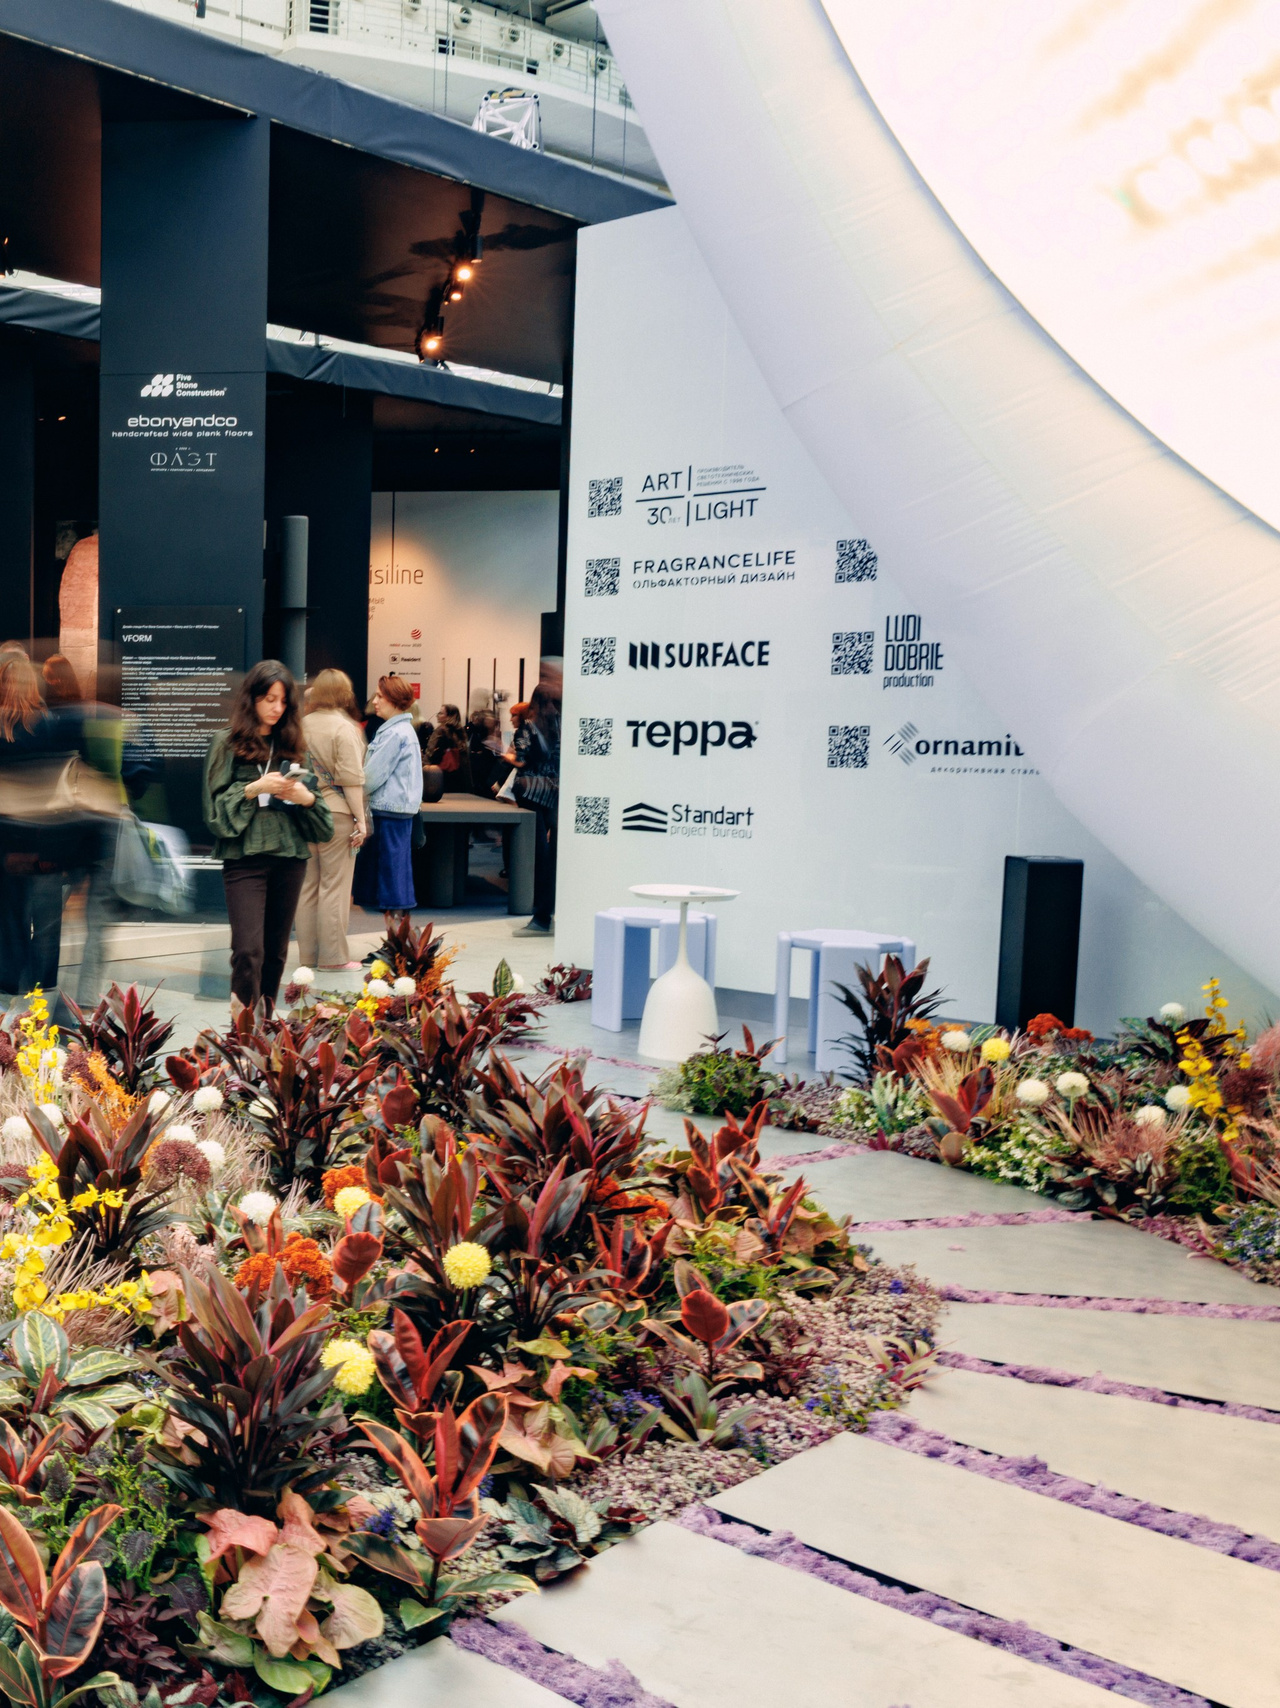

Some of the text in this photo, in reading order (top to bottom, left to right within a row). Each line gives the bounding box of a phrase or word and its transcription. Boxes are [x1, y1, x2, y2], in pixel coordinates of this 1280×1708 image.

[176, 373, 192, 381] Five
[176, 381, 198, 389] Stone
[175, 389, 225, 397] Construction
[127, 414, 238, 429] ebonyandco
[111, 430, 169, 438] handcrafted
[196, 430, 221, 438] plank
[641, 471, 683, 493] ART
[695, 498, 759, 521] LIGHT
[633, 550, 796, 574] FRAGRANCELIFE
[633, 570, 796, 589] ОЛЬФАКТОРНЫЙ ДИЗАЙН
[885, 614, 921, 642] LUDI
[122, 634, 153, 642] VFORM
[665, 640, 770, 668] SURFACE
[884, 643, 944, 671] DOBRIE
[883, 673, 934, 690] production
[671, 804, 754, 826] Standart
[670, 825, 753, 839] project bureau
